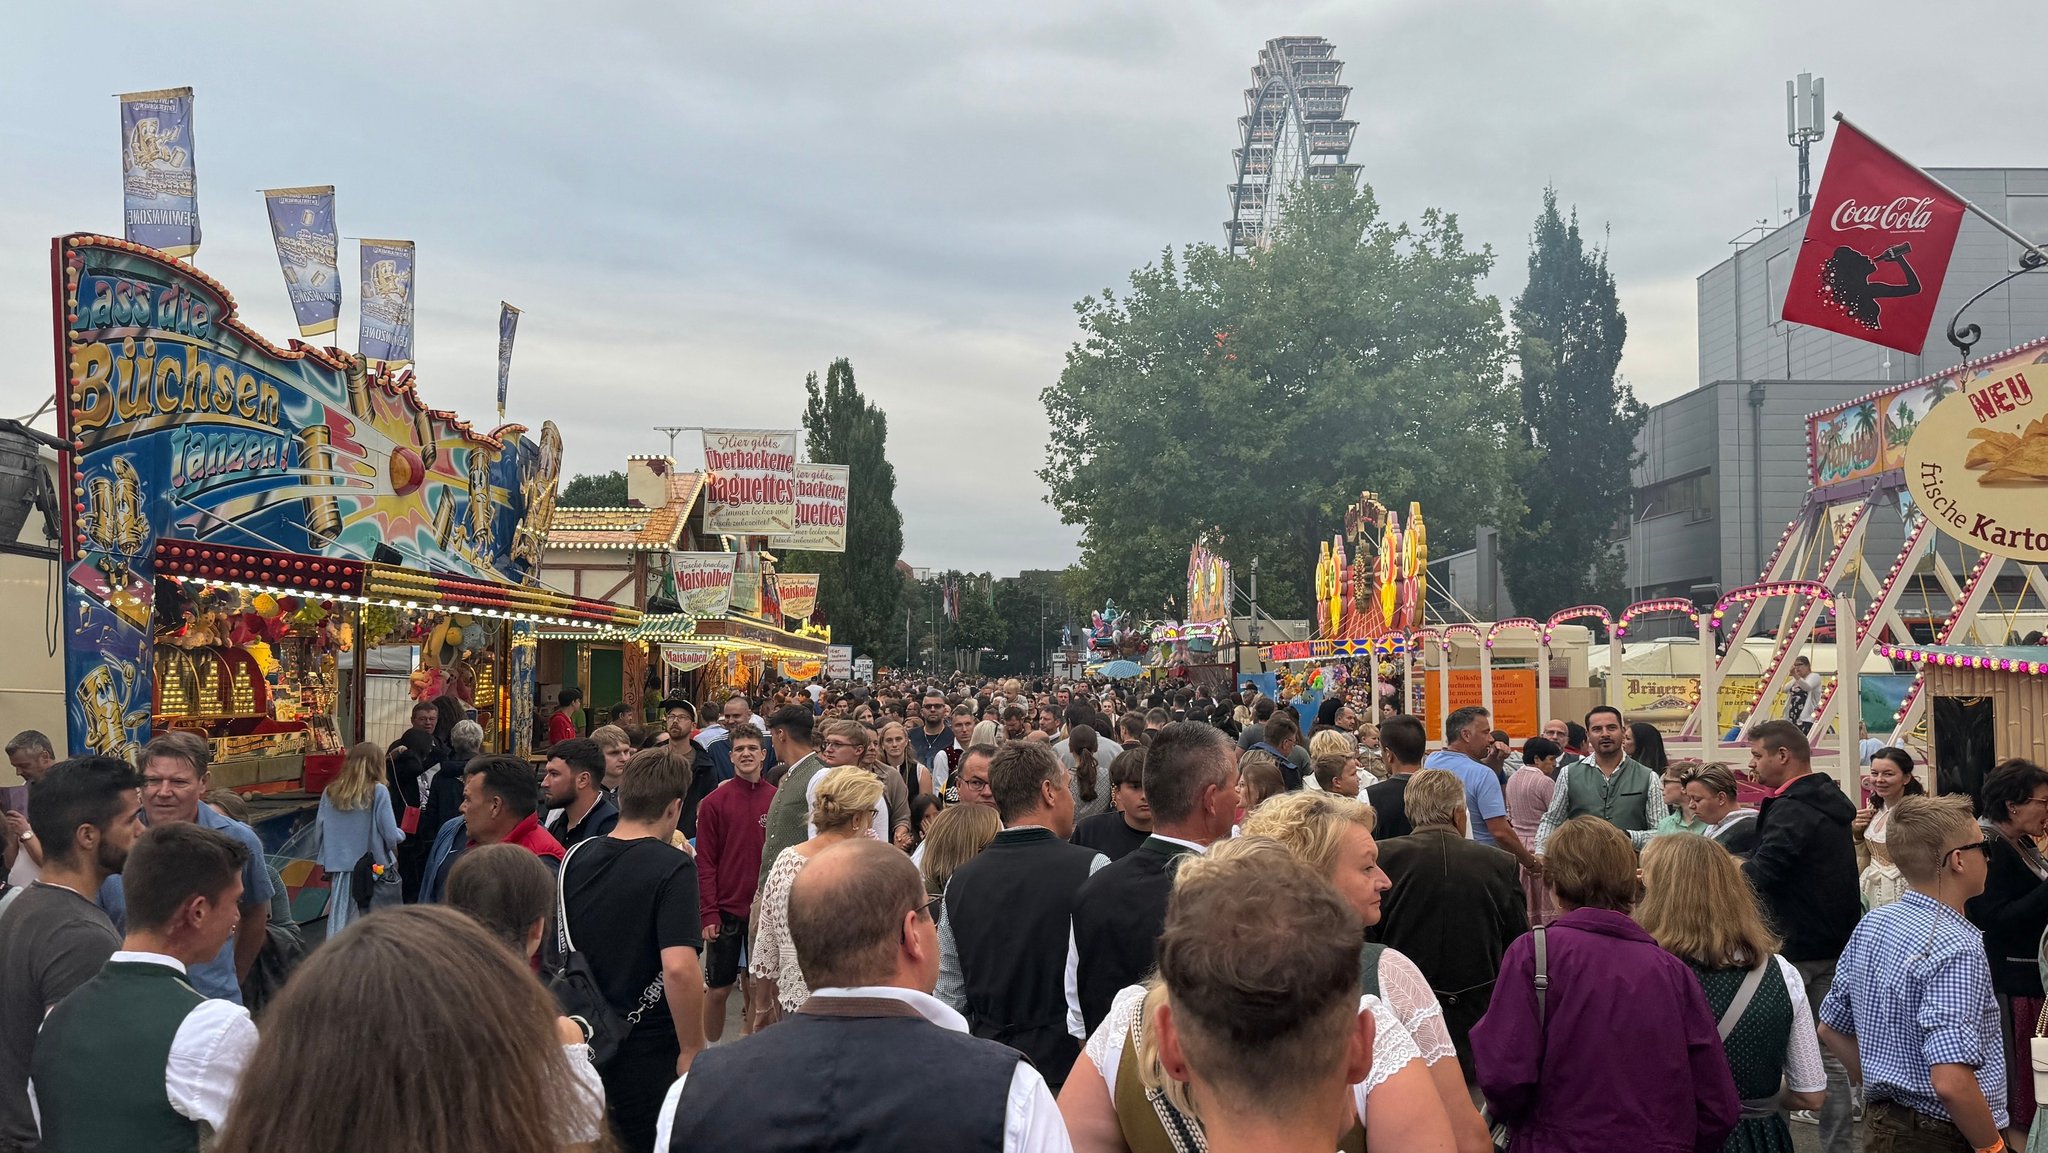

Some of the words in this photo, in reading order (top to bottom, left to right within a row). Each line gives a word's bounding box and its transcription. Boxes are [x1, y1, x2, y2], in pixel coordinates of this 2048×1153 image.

[1831, 197, 1936, 231] Coca-Cola
[158, 283, 212, 340] die
[73, 336, 281, 428] Büchsen
[1968, 373, 2033, 424] NEU
[718, 435, 749, 450] Hier
[750, 435, 781, 452] gibts
[705, 447, 794, 473] Überbackene
[796, 469, 810, 480] ier
[810, 469, 835, 481] gibts
[707, 473, 796, 508] Baguettes
[1921, 462, 1967, 529] frische
[675, 568, 733, 592] Maiskolben
[779, 585, 816, 600] Maiskolben
[665, 649, 708, 664] Maiskolben
